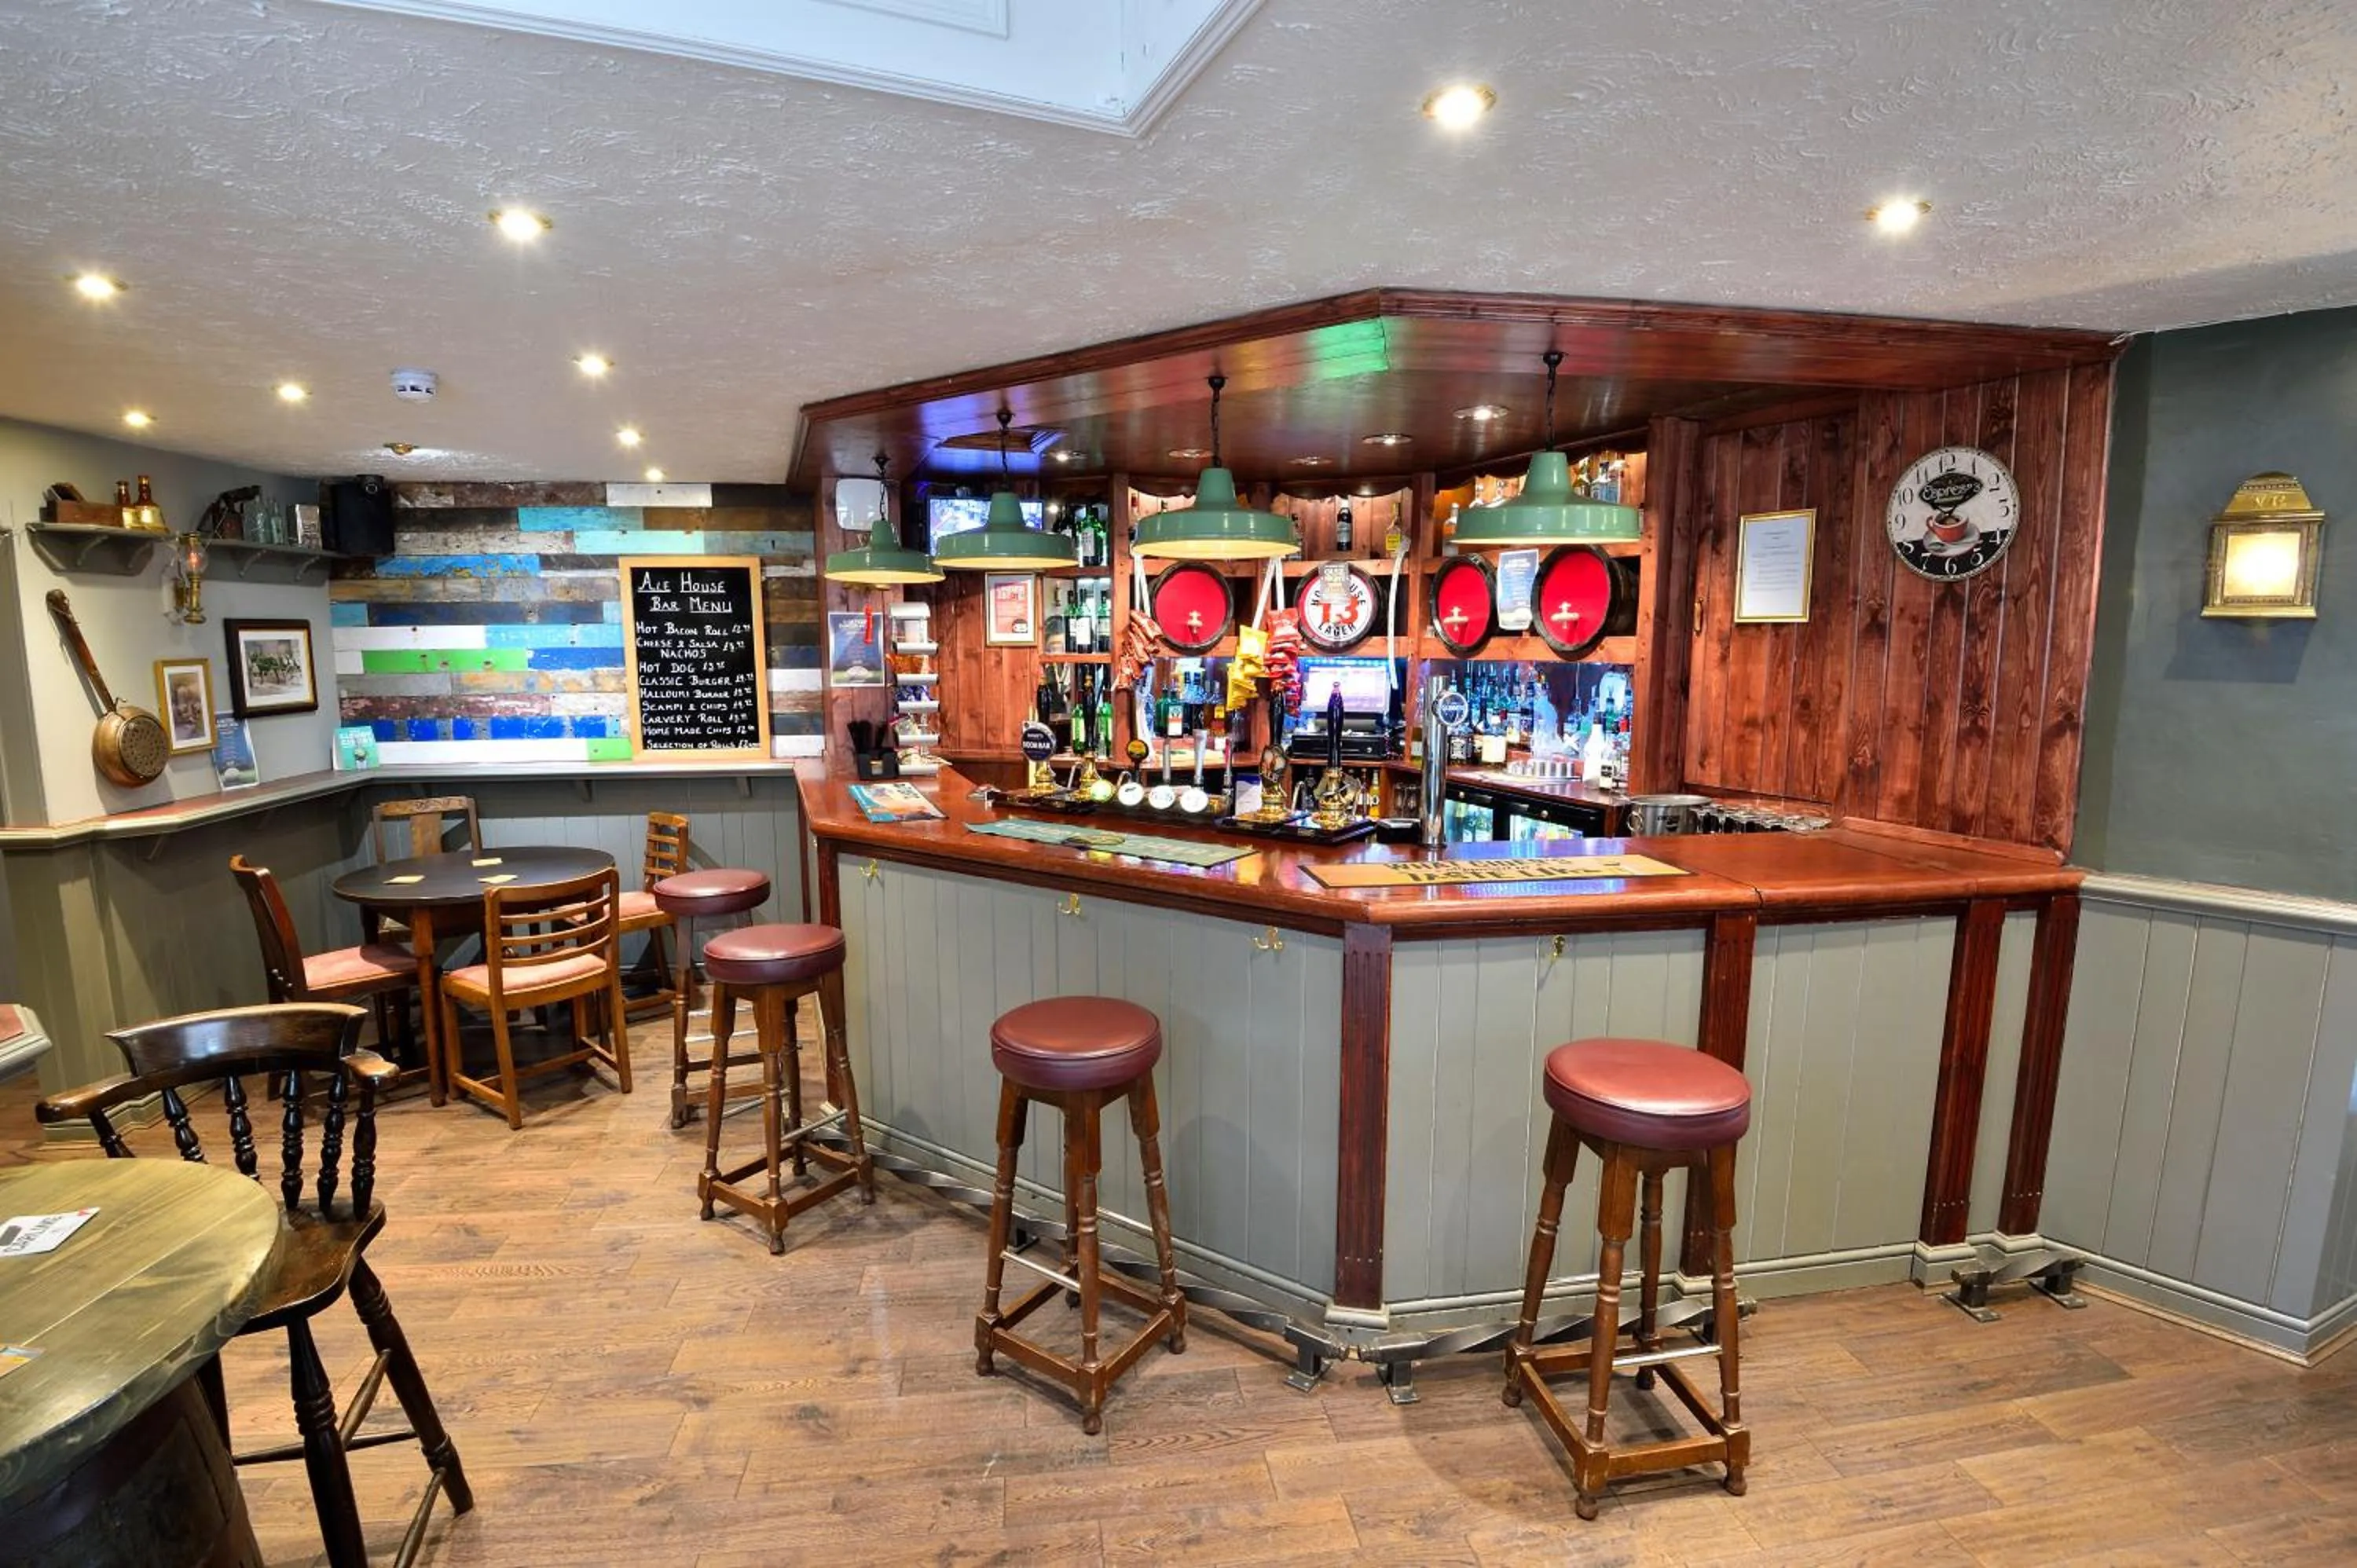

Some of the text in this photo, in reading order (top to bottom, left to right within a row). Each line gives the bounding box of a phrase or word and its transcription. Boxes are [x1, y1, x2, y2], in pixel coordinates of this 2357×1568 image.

[1939, 454, 1956, 473] 12
[1988, 473, 2000, 492] 2
[1897, 487, 1914, 505] 10
[1894, 512, 1906, 529] 9
[1989, 528, 2002, 544] 4
[1945, 557, 1957, 575] 6
[690, 596, 733, 613] MENU
[636, 621, 658, 634] HOT
[660, 649, 706, 659] NACHOS
[639, 661, 660, 673] HOT
[670, 662, 695, 673] DOG
[639, 675, 684, 686] CLASSIC
